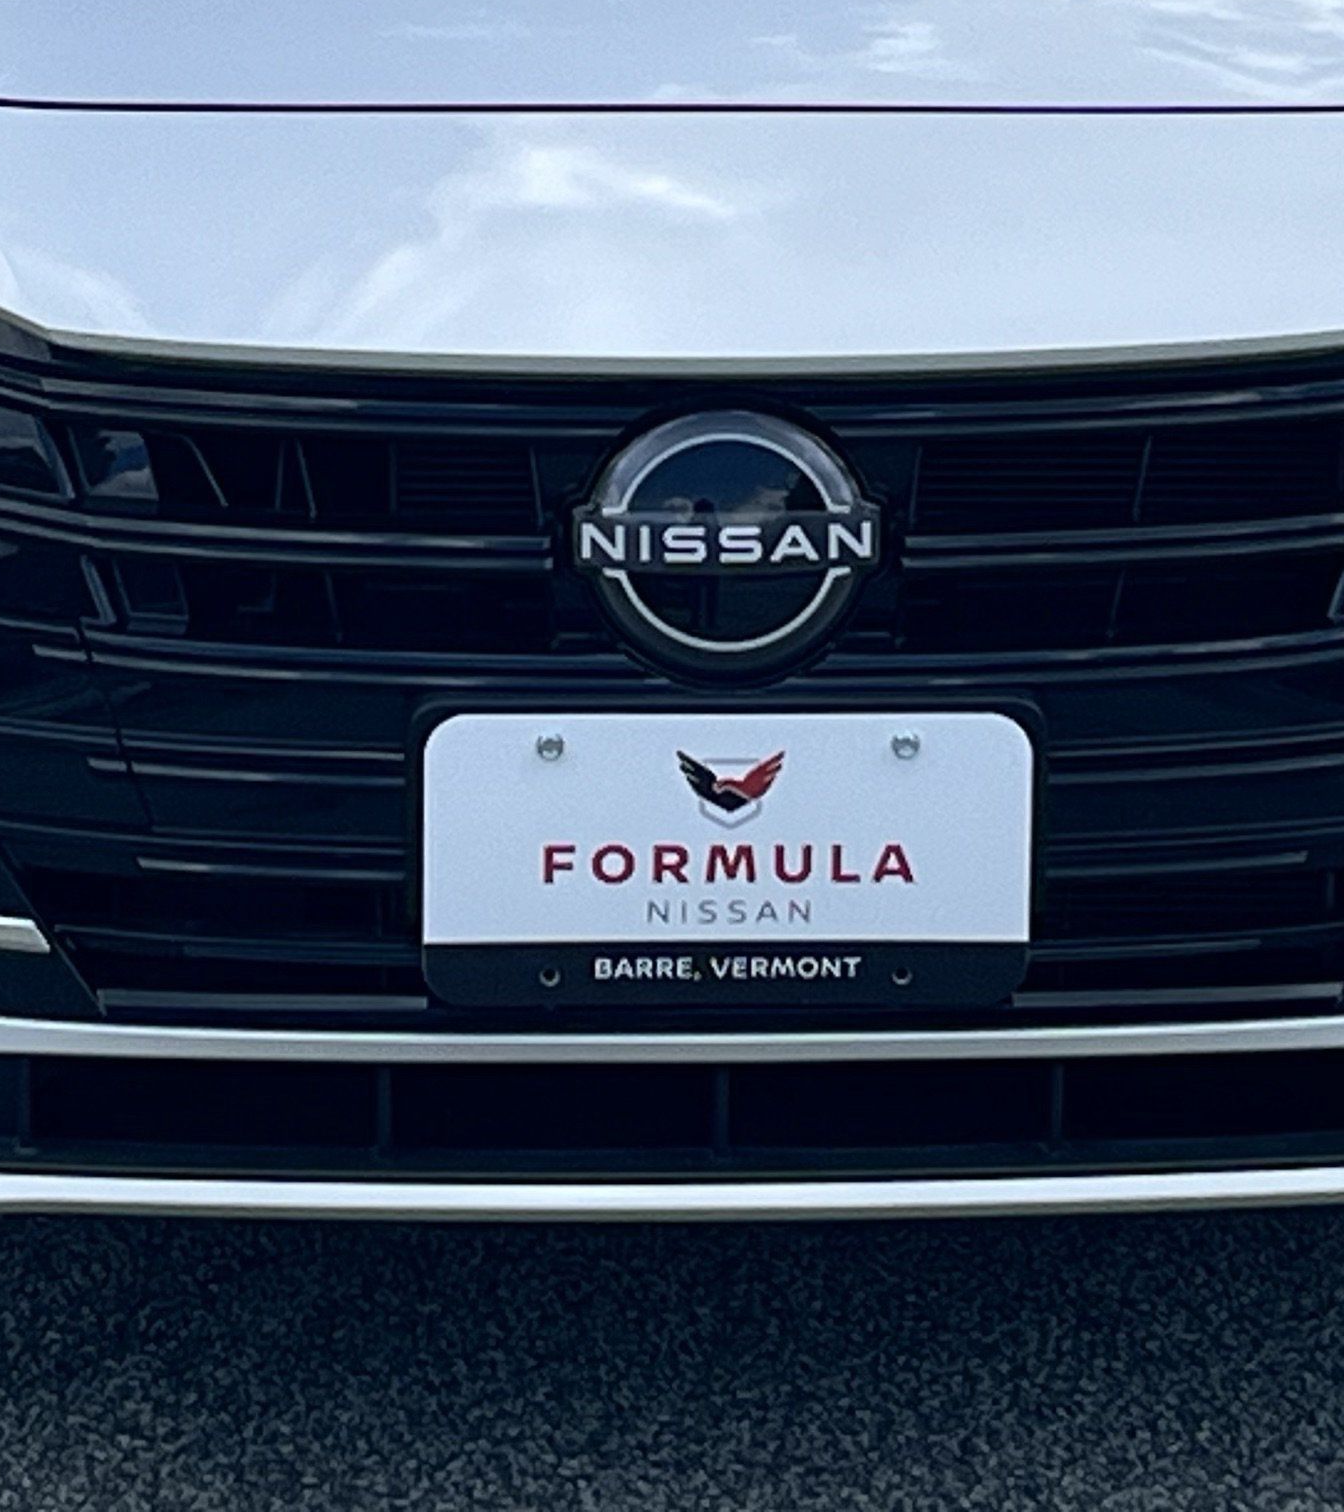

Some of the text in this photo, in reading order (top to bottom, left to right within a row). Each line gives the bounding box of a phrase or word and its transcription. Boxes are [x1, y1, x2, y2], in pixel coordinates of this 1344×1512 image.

[580, 521, 873, 563] NISSAN
[542, 844, 915, 884] FORMULA
[647, 900, 812, 925] NISSAN
[594, 956, 862, 981] BARRE, VERMONT
